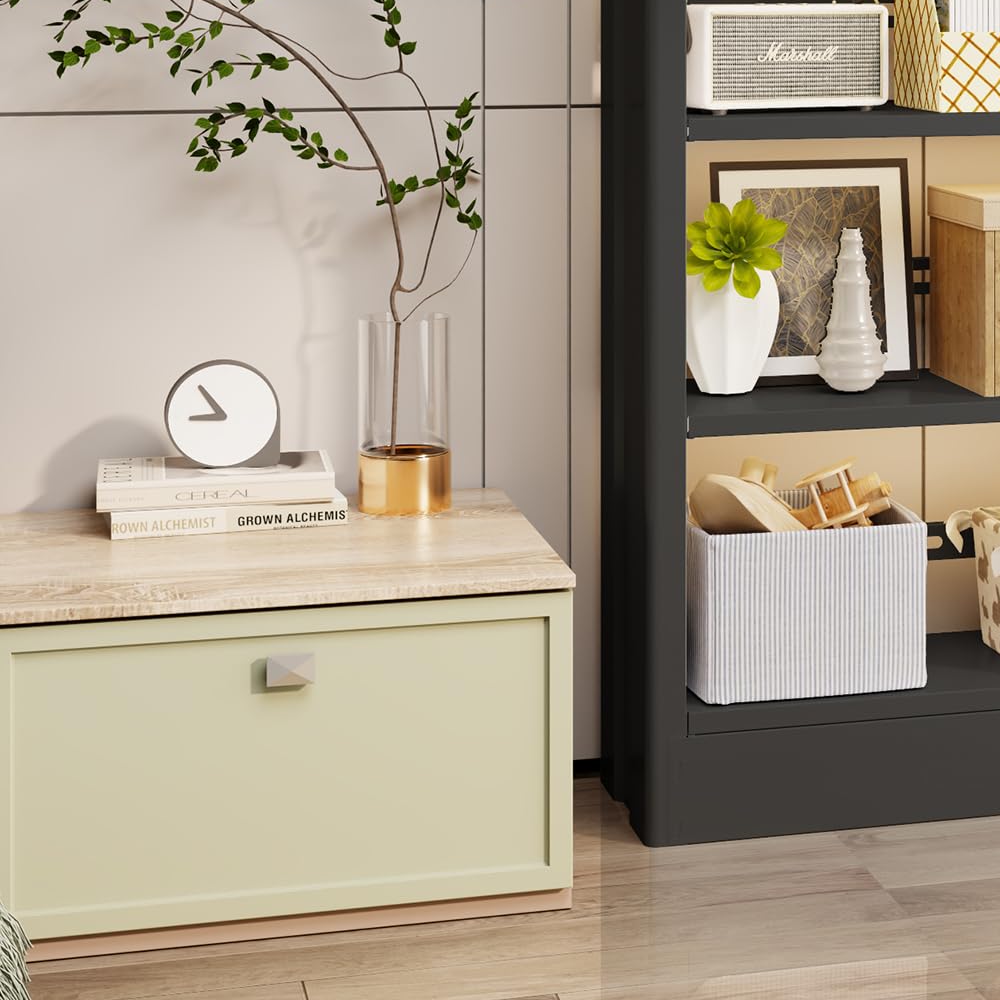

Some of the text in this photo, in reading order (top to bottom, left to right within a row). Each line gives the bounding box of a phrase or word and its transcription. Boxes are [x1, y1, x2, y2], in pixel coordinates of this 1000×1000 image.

[757, 41, 840, 62] Marshall
[174, 488, 254, 502] CEREAL
[152, 516, 216, 532] ALCHEMIST
[237, 514, 283, 527] GROWN
